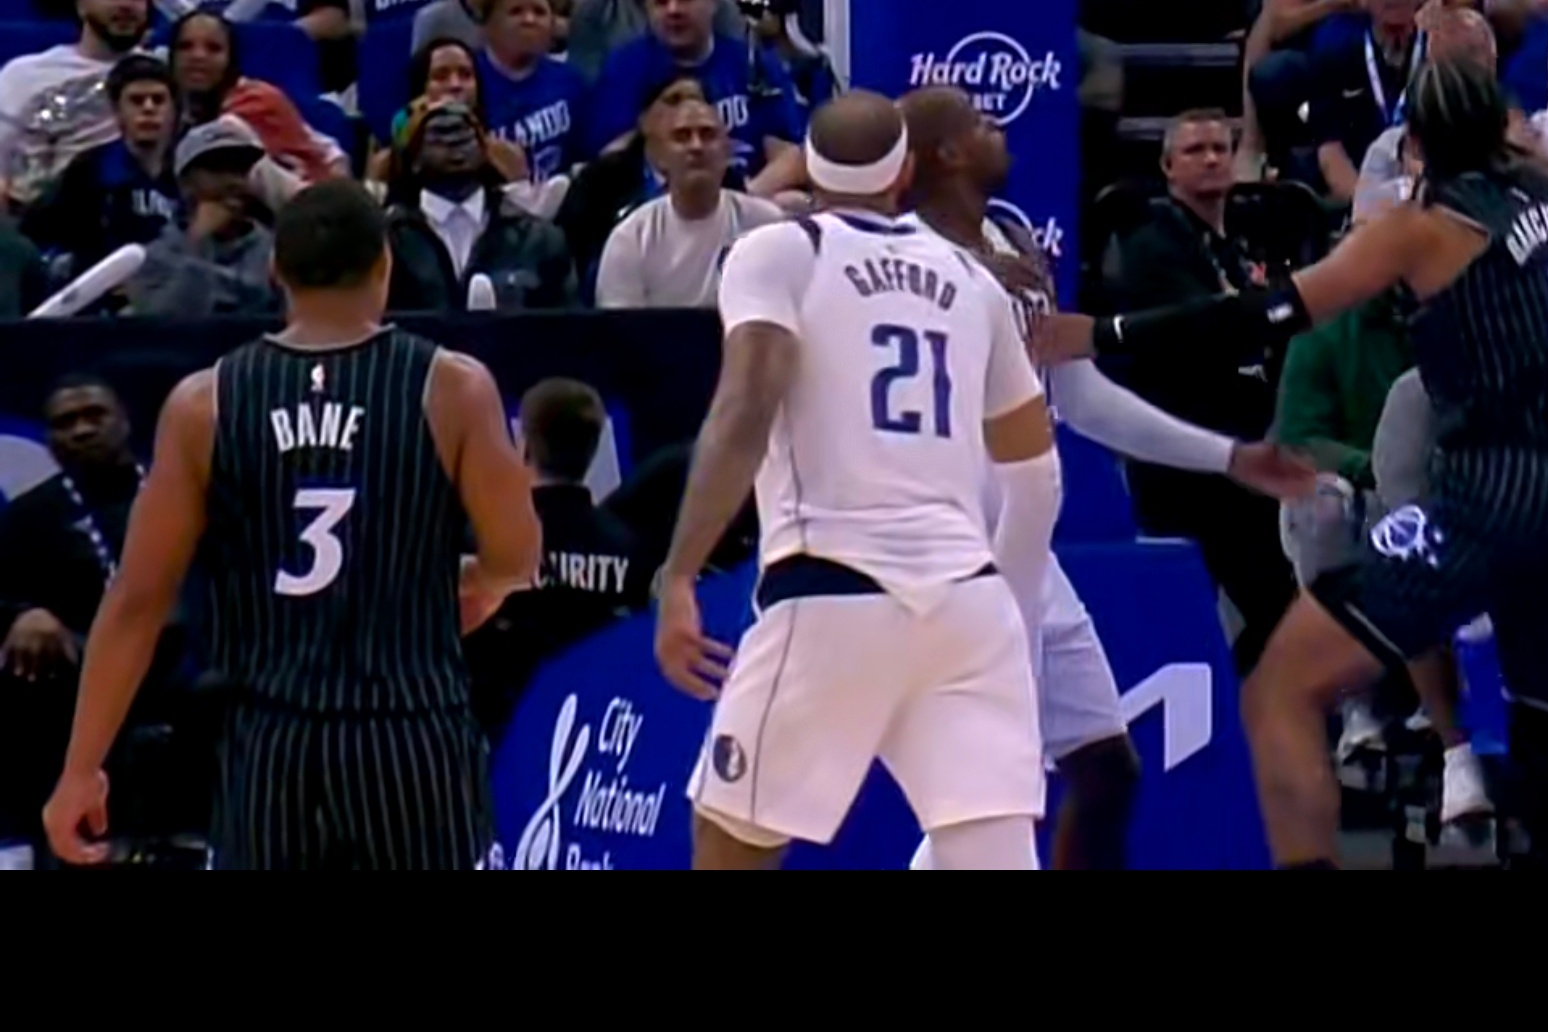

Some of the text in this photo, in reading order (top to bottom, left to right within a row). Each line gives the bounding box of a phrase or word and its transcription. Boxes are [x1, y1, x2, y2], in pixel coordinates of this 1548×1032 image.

[908, 50, 1062, 90] Hard Rock
[844, 257, 957, 311] GAFFORD
[870, 323, 952, 439] 21
[269, 400, 367, 453] BANE
[273, 486, 358, 597] 3
[531, 550, 630, 595] CURITY
[597, 695, 645, 774] City
[573, 767, 668, 838] National
